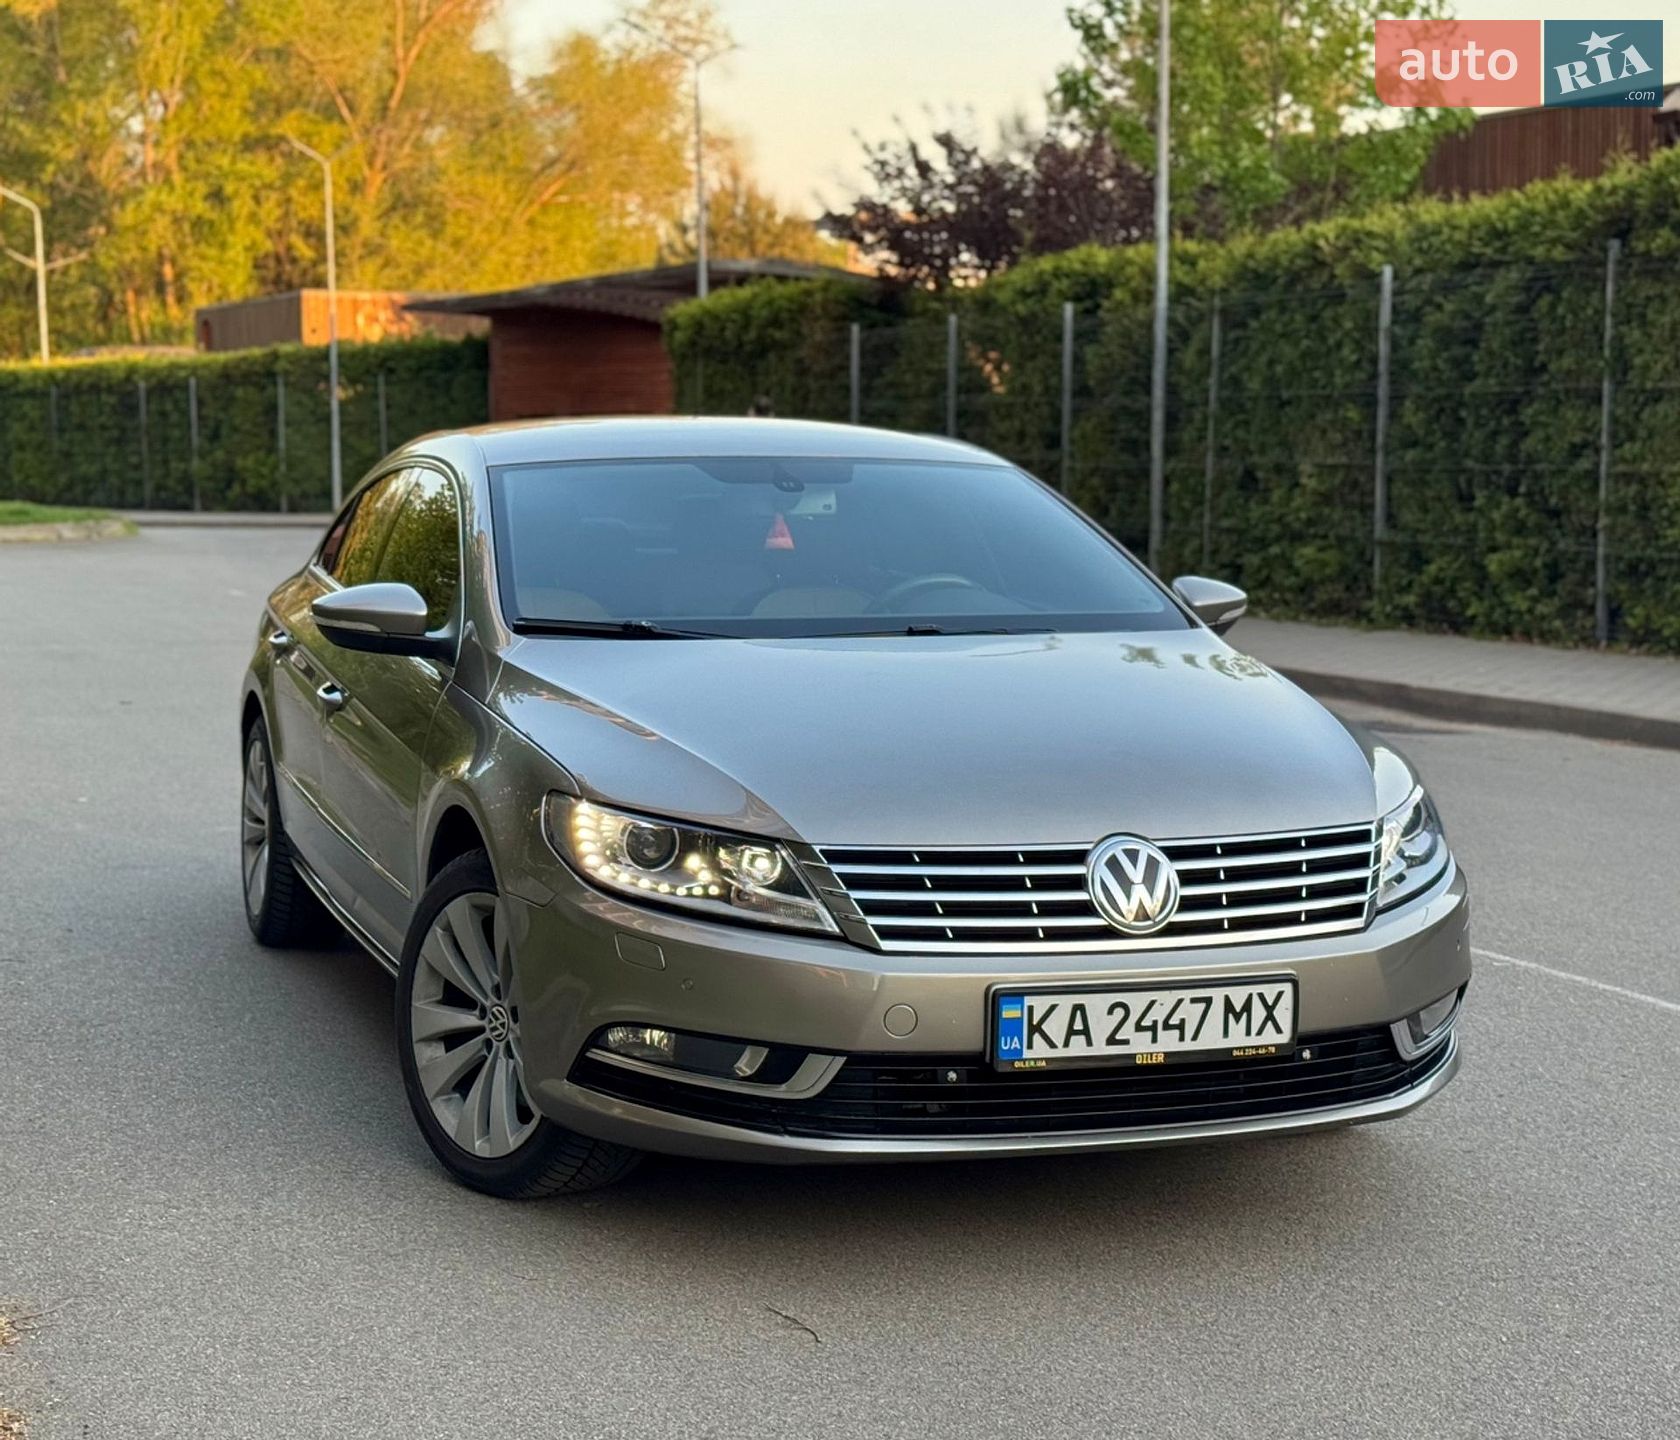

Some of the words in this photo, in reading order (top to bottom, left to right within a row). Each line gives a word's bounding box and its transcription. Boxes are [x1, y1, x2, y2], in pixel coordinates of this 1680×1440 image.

[1026, 1003, 1094, 1050] KA
[1105, 996, 1214, 1046] 2447
[1222, 990, 1286, 1039] MX
[1001, 1036, 1021, 1050] UA
[1135, 1053, 1165, 1064] OILER
